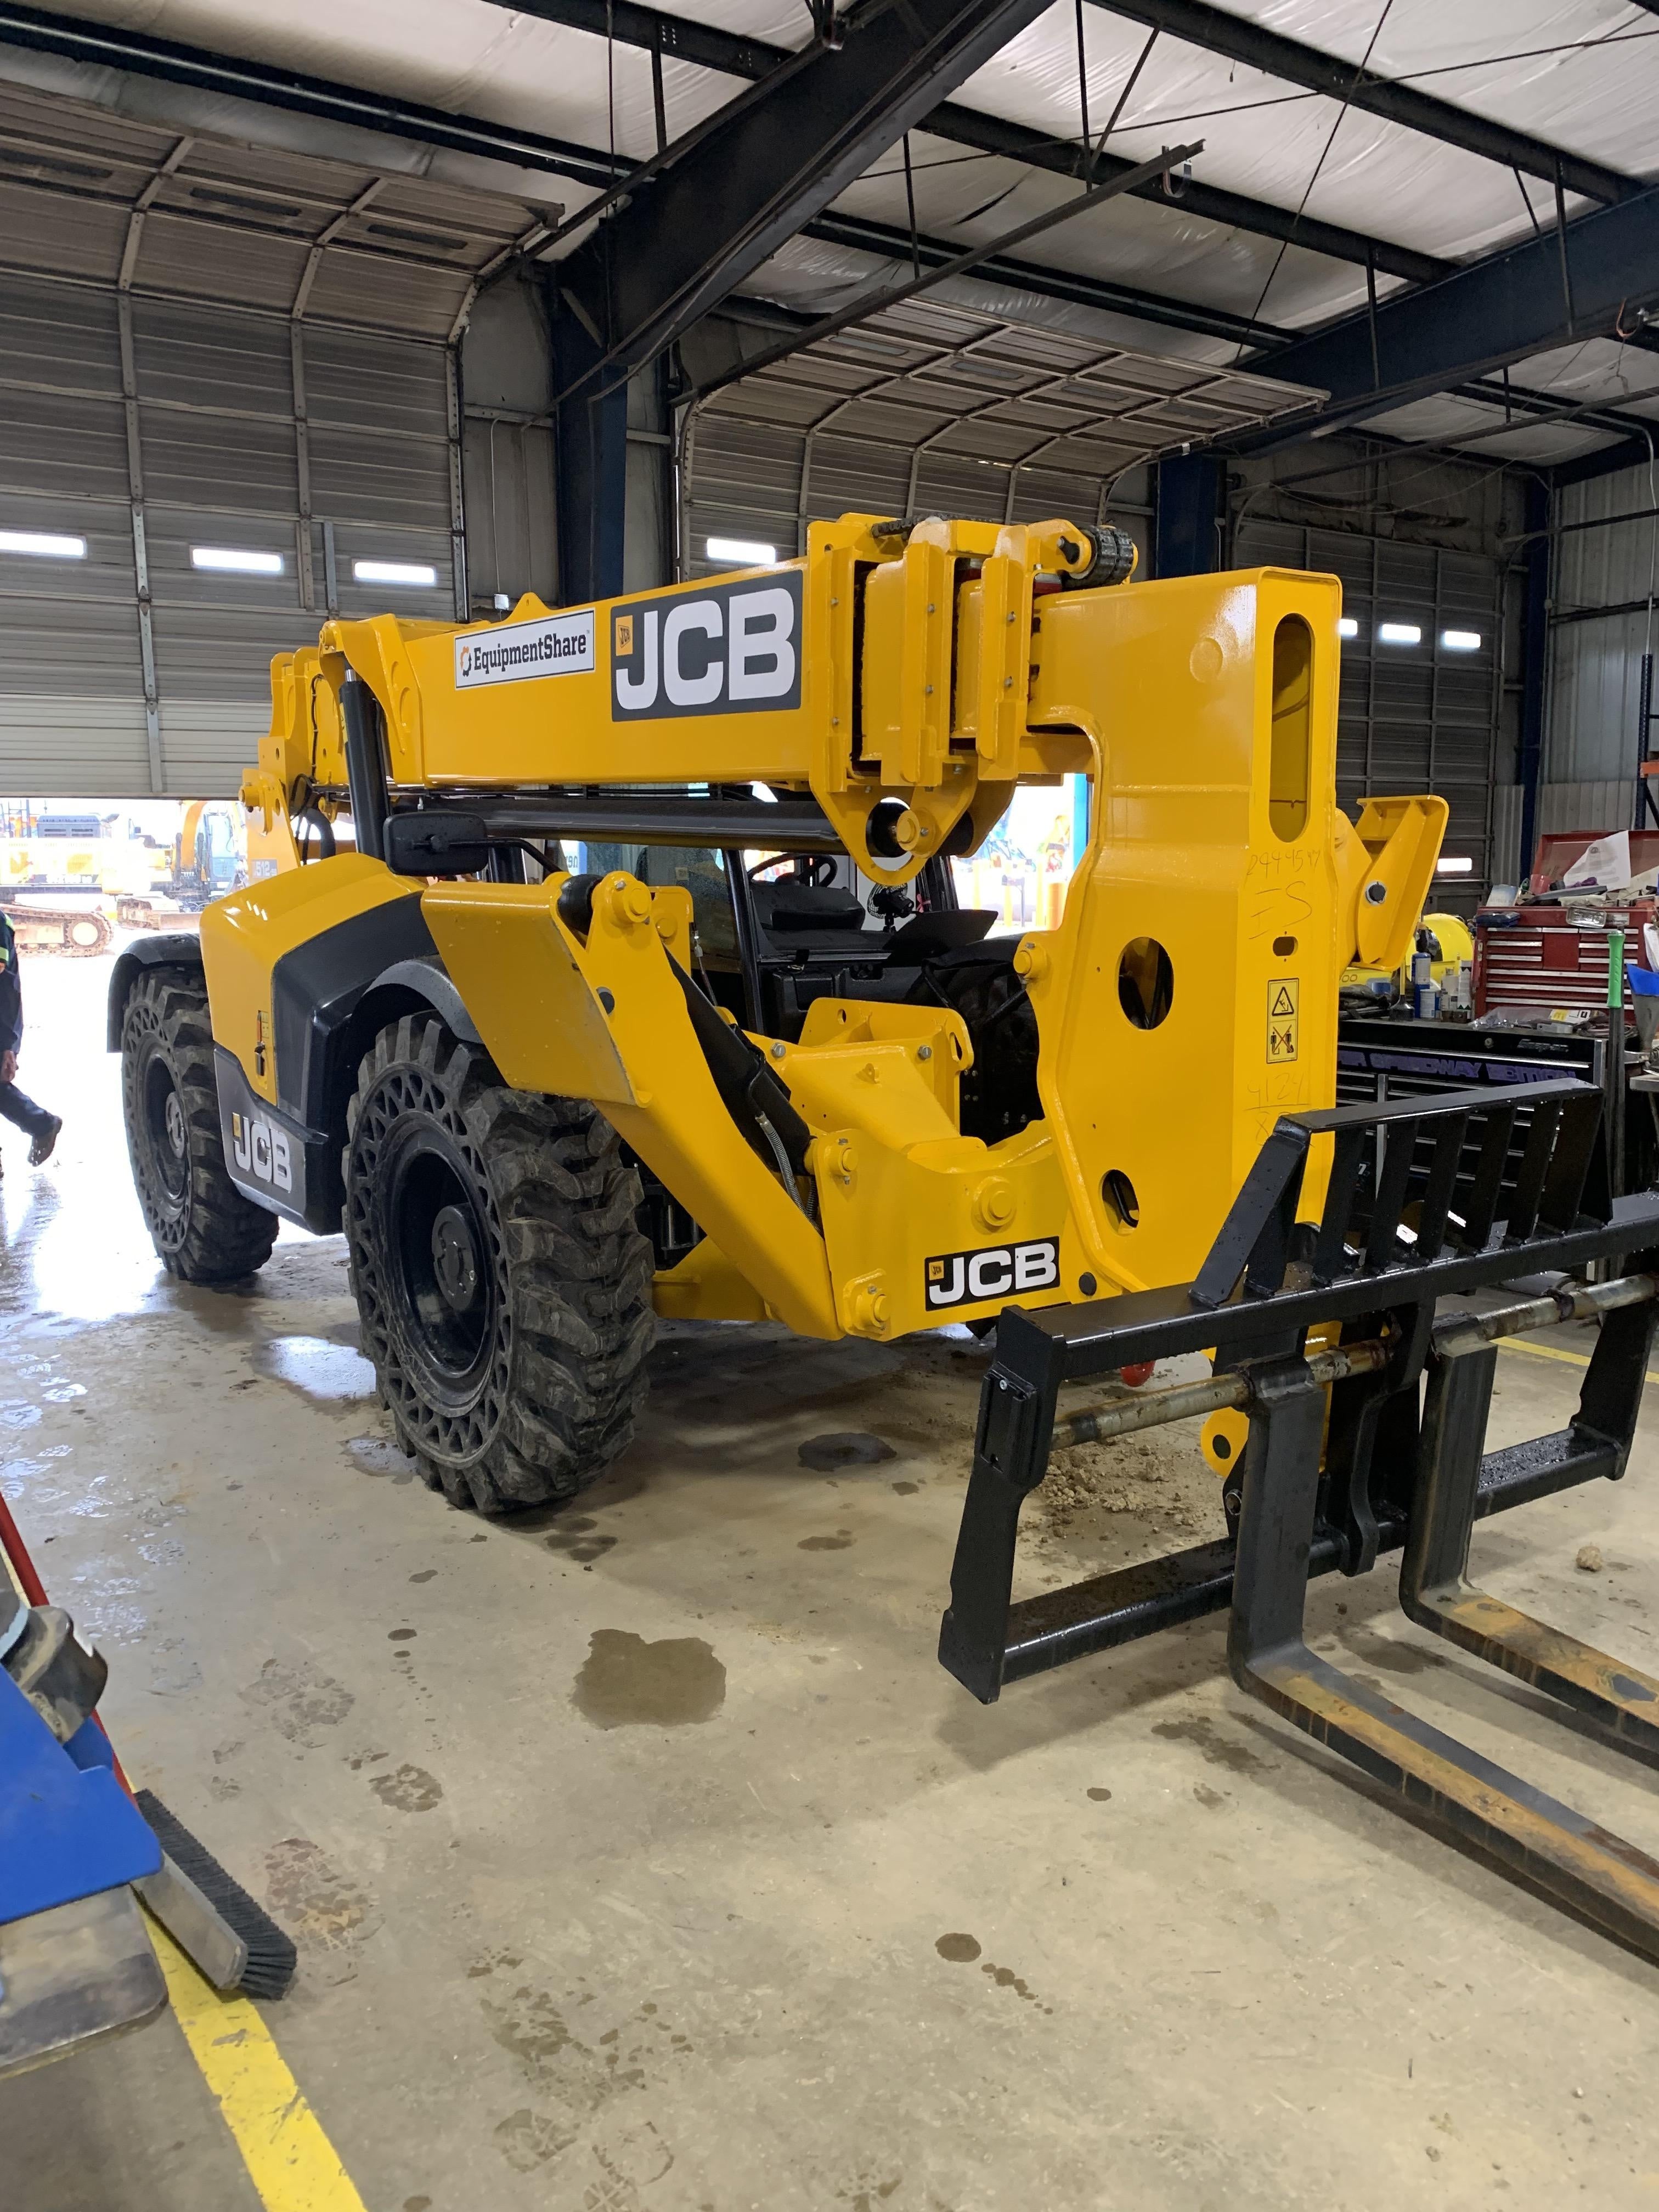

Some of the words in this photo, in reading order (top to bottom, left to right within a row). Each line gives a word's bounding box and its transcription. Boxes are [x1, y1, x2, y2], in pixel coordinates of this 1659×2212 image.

[474, 633, 586, 674] EquipmentShare
[616, 588, 795, 710] JCB
[234, 1116, 292, 1193] JCB
[929, 1242, 1057, 1305] JCB
